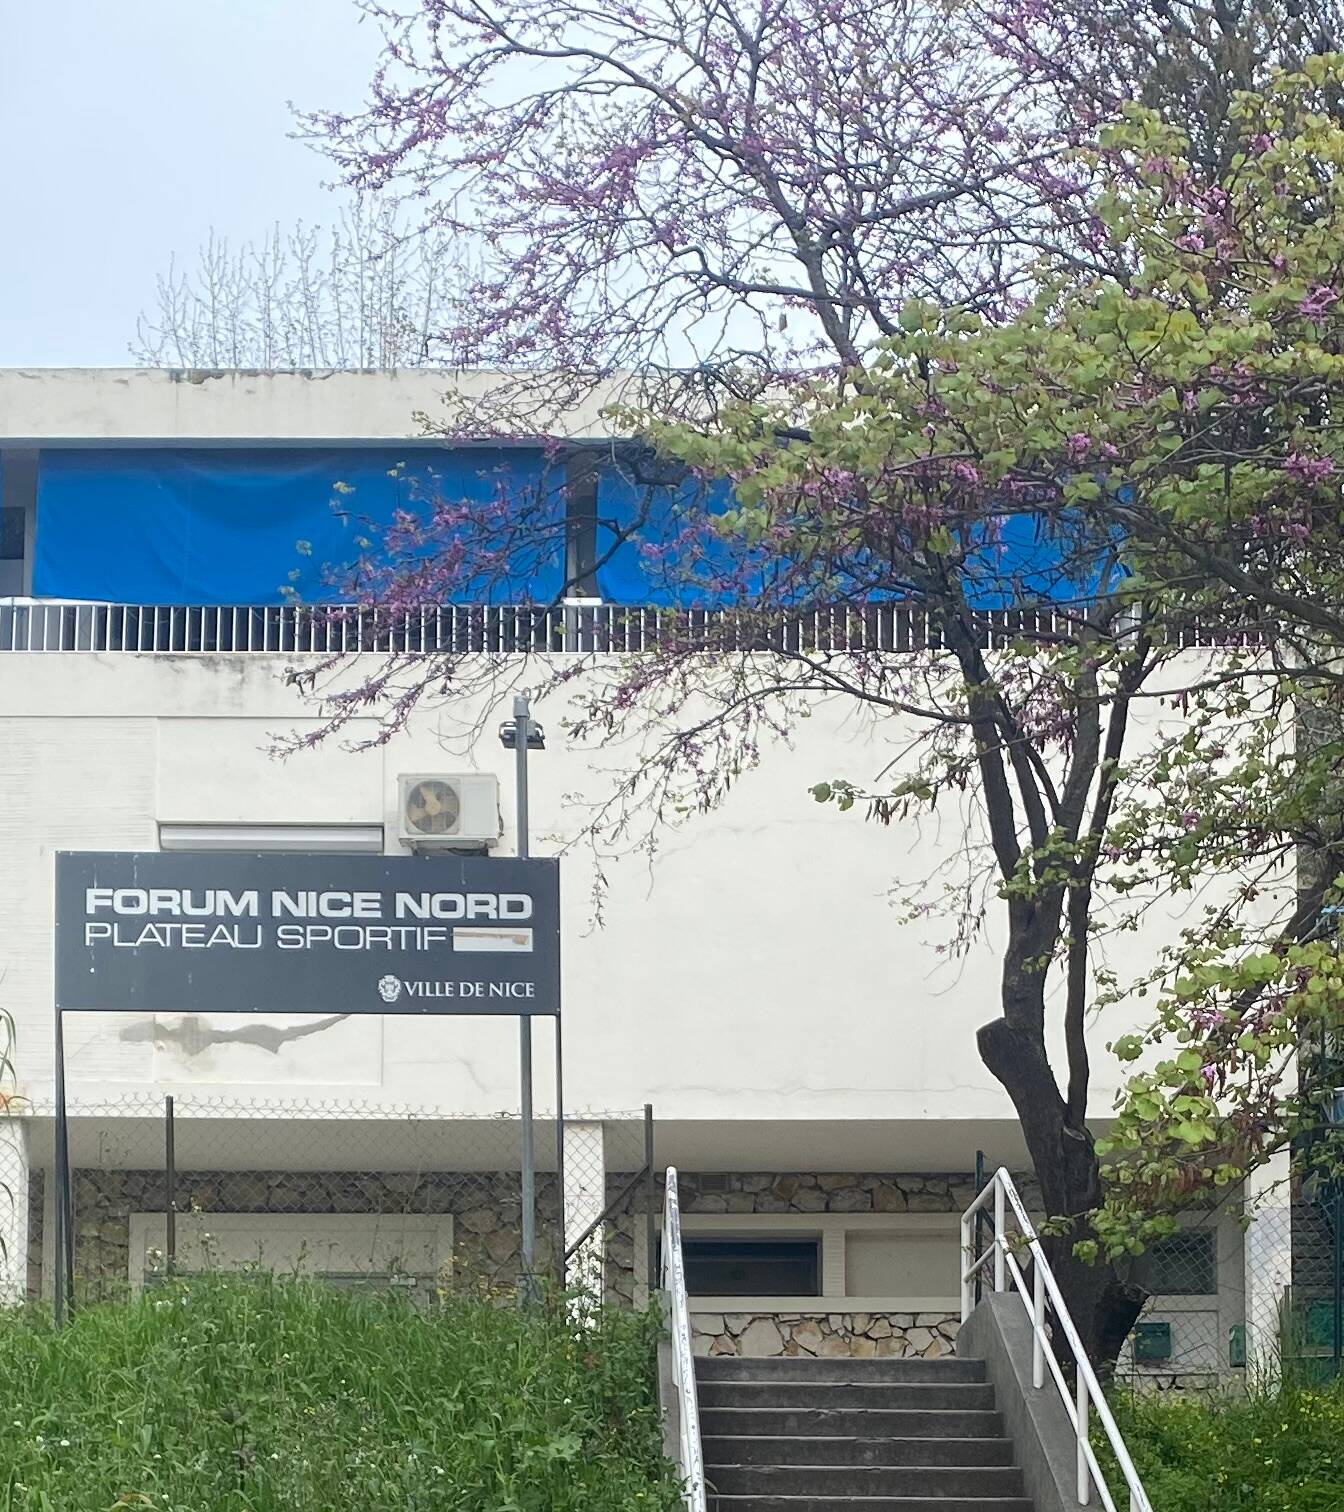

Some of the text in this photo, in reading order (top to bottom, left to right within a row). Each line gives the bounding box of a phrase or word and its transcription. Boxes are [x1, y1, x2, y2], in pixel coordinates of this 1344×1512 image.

[85, 888, 533, 920] FORUM NICE NORD
[85, 922, 447, 951] PLATEAU SPORTIF
[403, 981, 535, 998] VILLE DE NICE
